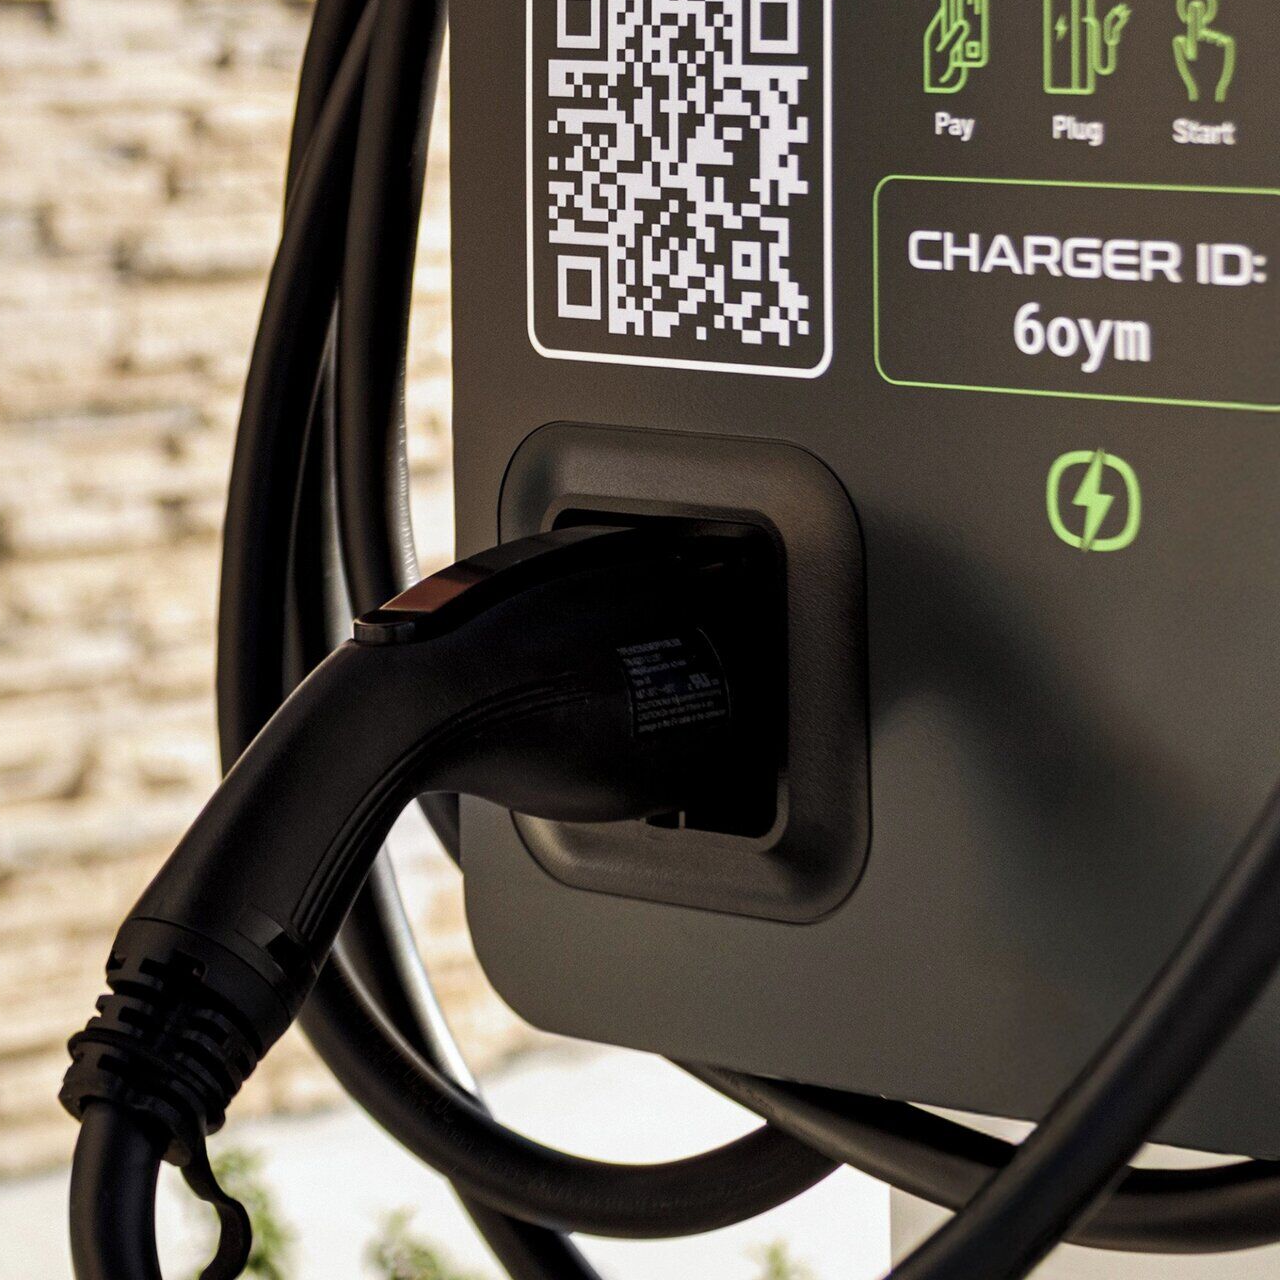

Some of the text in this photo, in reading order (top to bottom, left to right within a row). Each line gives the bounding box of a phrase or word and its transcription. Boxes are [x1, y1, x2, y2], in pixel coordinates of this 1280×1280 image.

[934, 111, 976, 142] Pay
[1051, 114, 1105, 147] Plug
[1171, 117, 1237, 146] Start
[907, 229, 1268, 287] CHARGER ID:
[1013, 301, 1152, 374] 6oym
